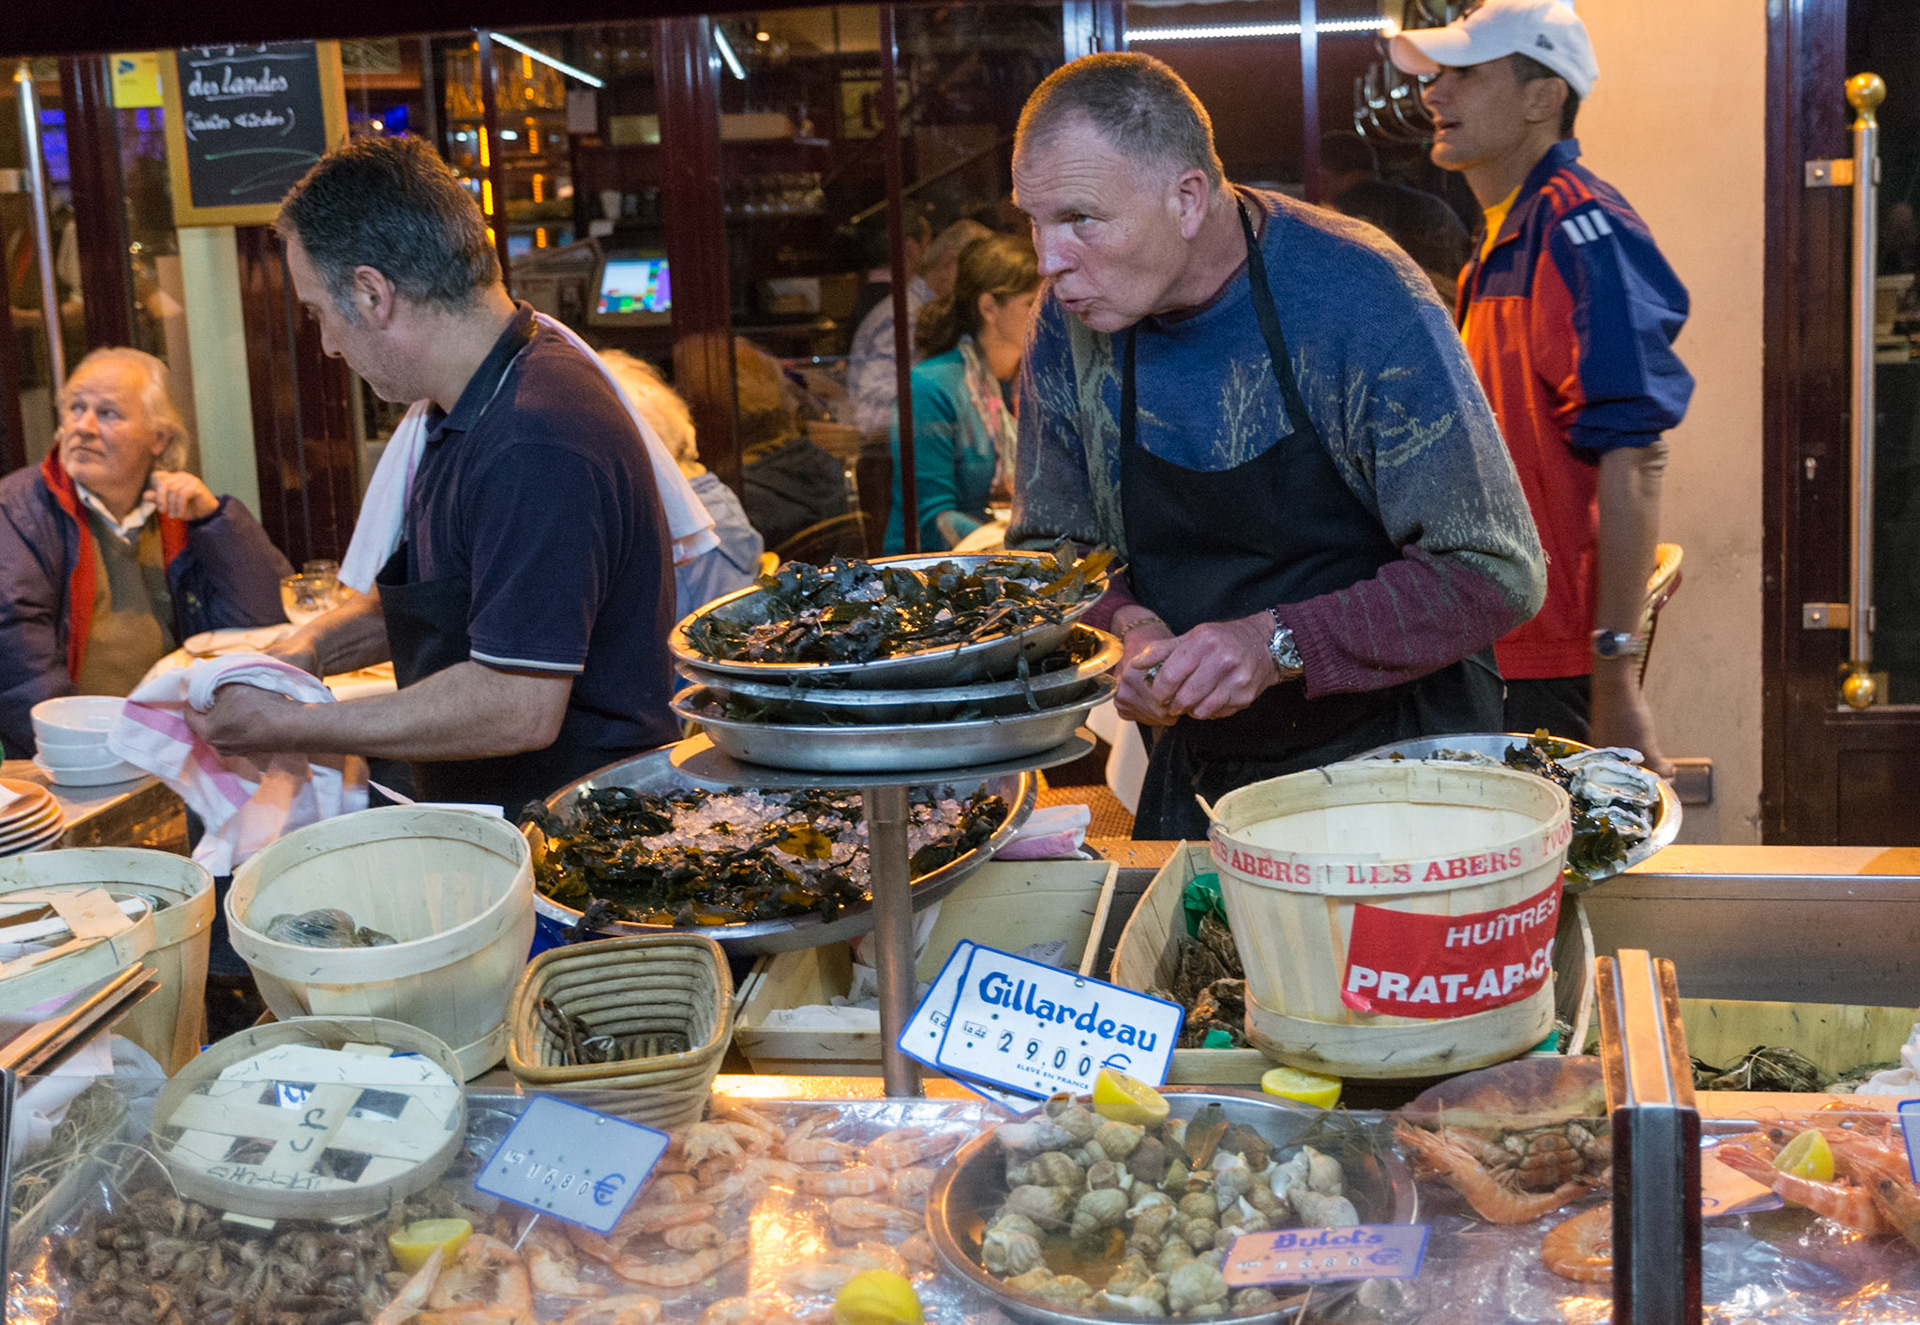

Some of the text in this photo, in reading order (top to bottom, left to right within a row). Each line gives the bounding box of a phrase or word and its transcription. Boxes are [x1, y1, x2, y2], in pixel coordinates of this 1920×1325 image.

[188, 68, 219, 97] des
[1230, 849, 1312, 885] ABERS
[1346, 864, 1413, 885] LES
[1422, 847, 1522, 882] ABERS
[1445, 890, 1557, 948] HUÎTRES
[978, 971, 1157, 1052] Gillardeau
[1057, 1076, 1089, 1089] FRANCE
[1269, 1230, 1384, 1249] Bulots
